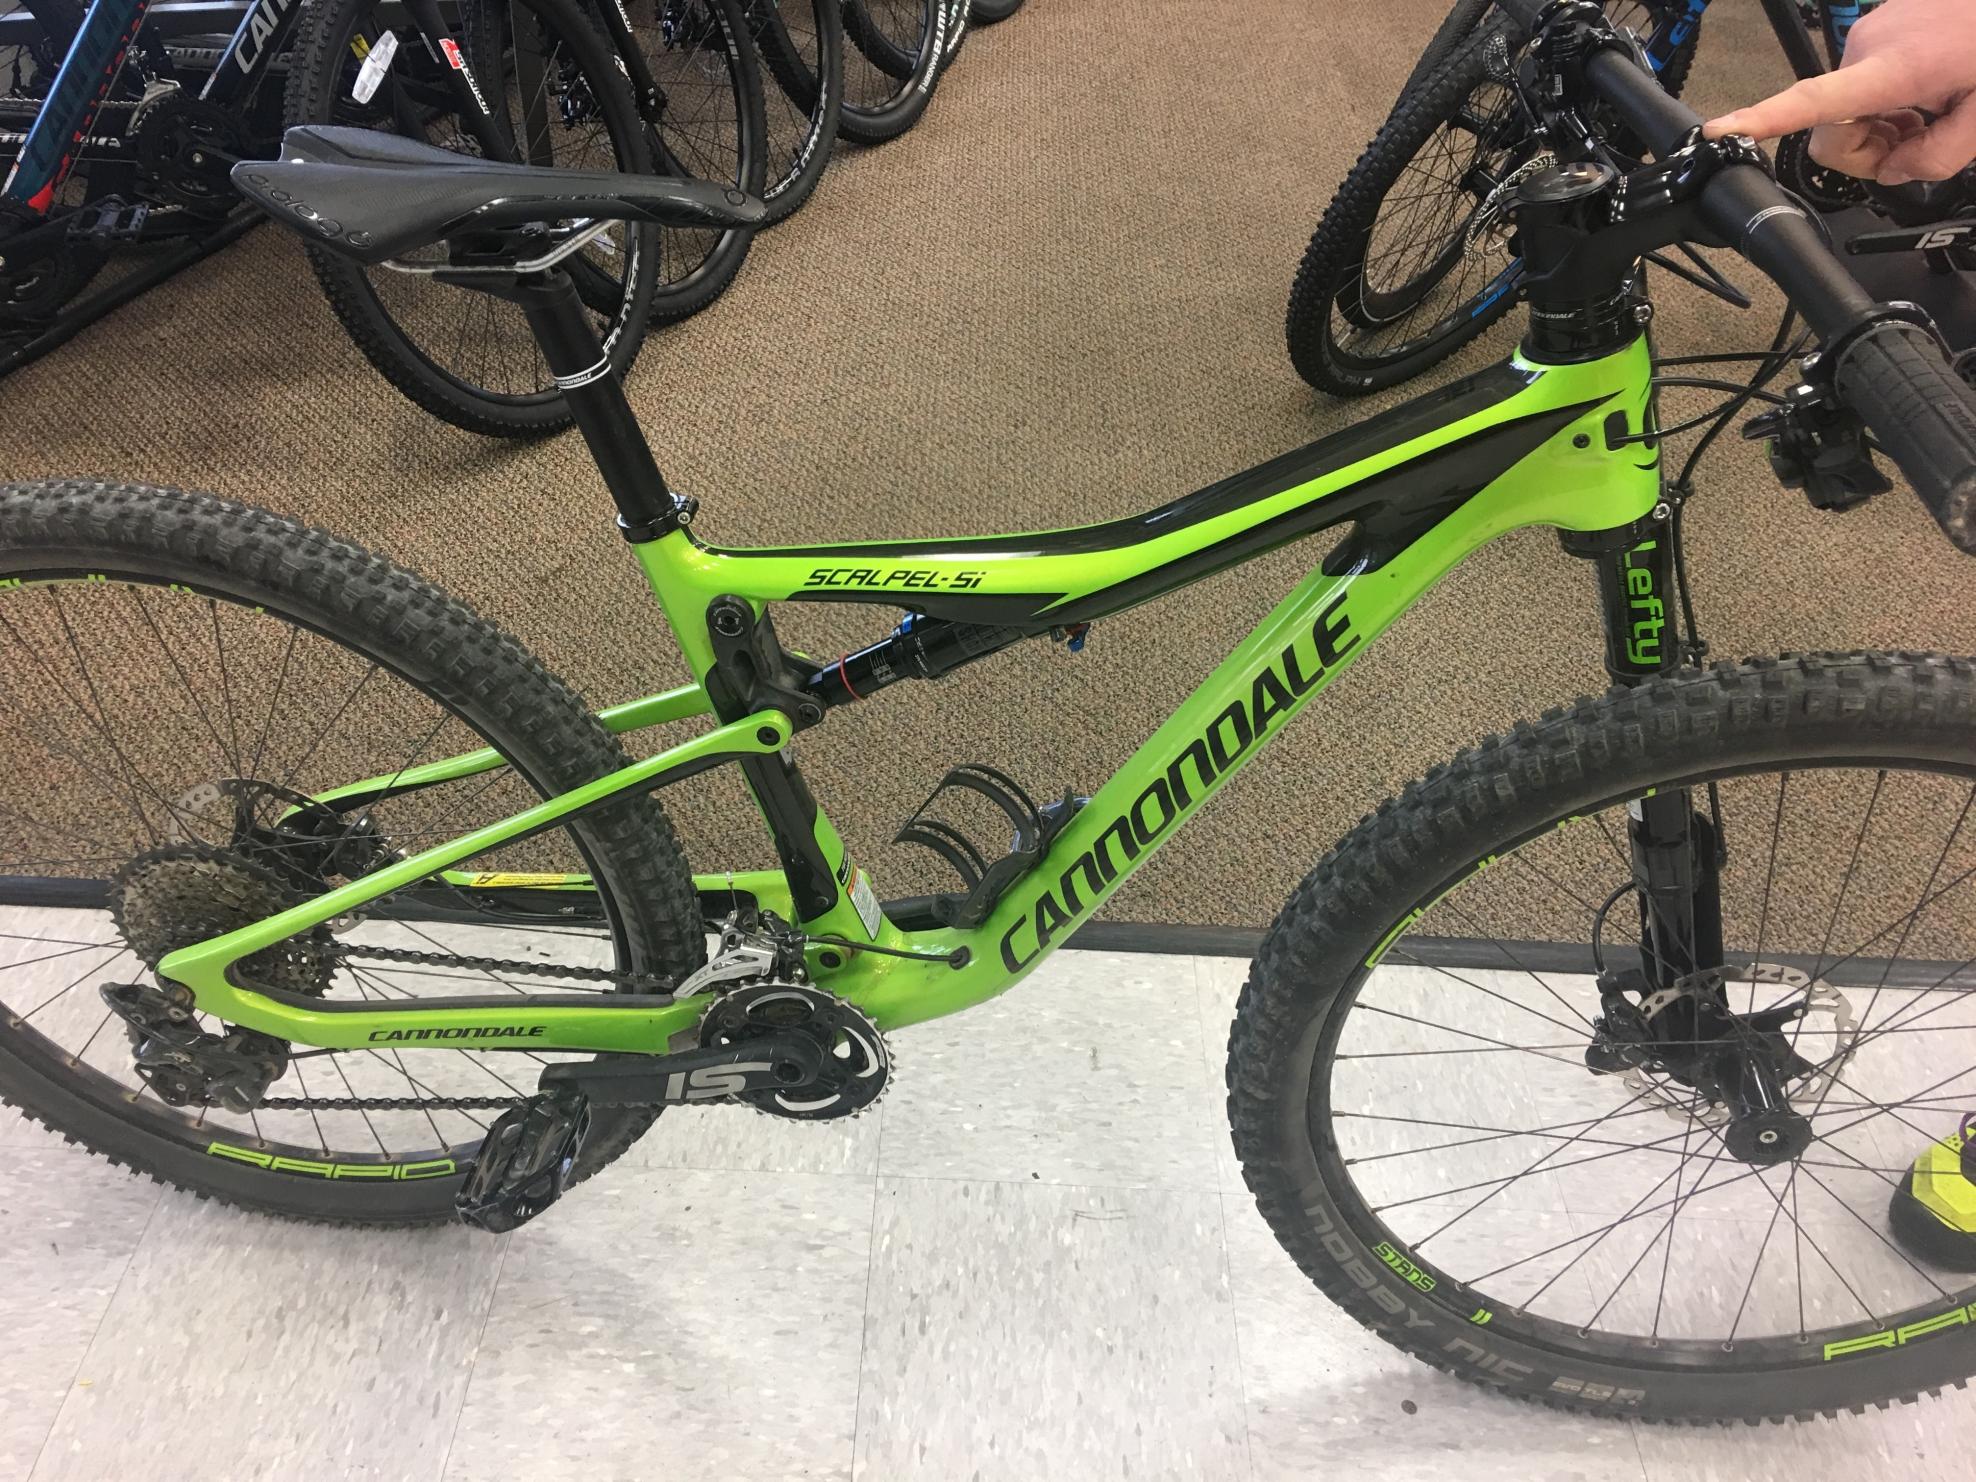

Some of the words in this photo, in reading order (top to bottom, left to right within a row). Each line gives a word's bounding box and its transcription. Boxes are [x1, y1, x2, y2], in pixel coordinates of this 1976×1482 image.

[1624, 540, 1665, 665] Lefty
[1000, 589, 1362, 974] CANNONDALE
[368, 1026, 548, 1042] CANNONDALE
[1305, 1204, 1437, 1329] NOBBY
[1442, 1337, 1534, 1383] NIC
[1374, 1242, 1436, 1291] STANS
